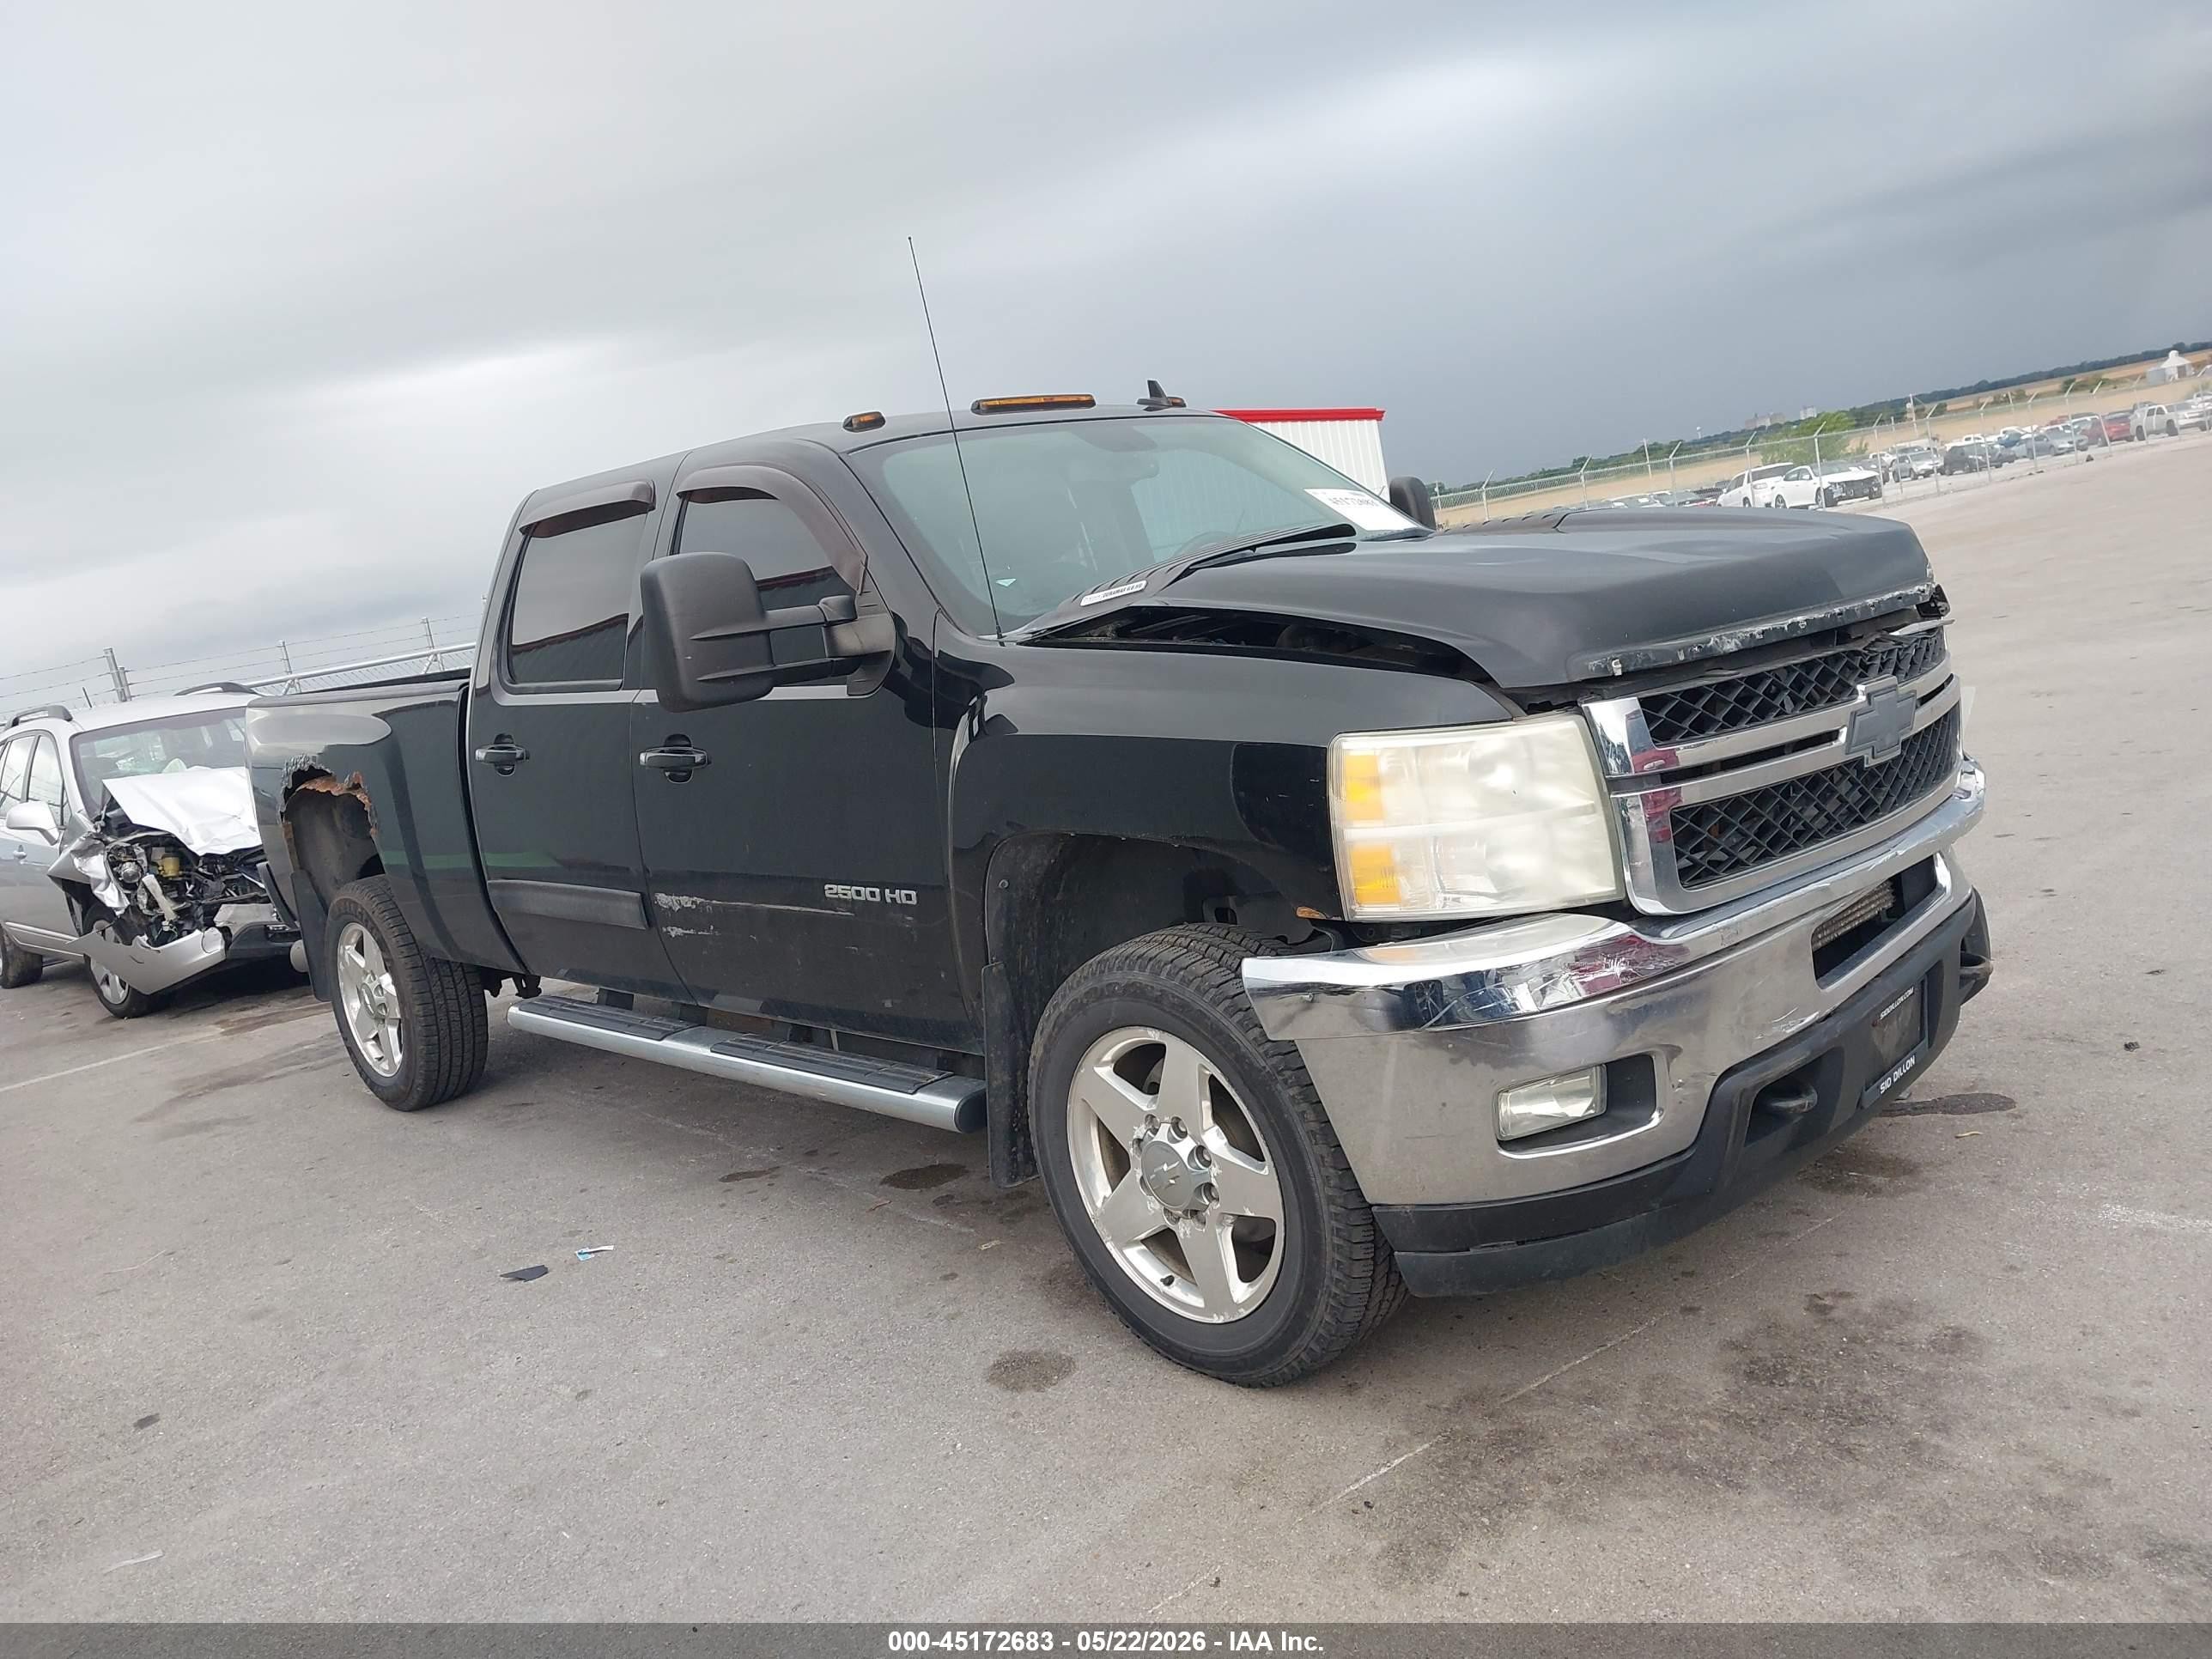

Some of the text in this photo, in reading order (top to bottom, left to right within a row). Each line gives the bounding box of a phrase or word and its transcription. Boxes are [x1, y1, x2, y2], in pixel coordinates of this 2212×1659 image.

[824, 884, 917, 905] 2500 HD
[1880, 1054, 1916, 1095] SID DILLON
